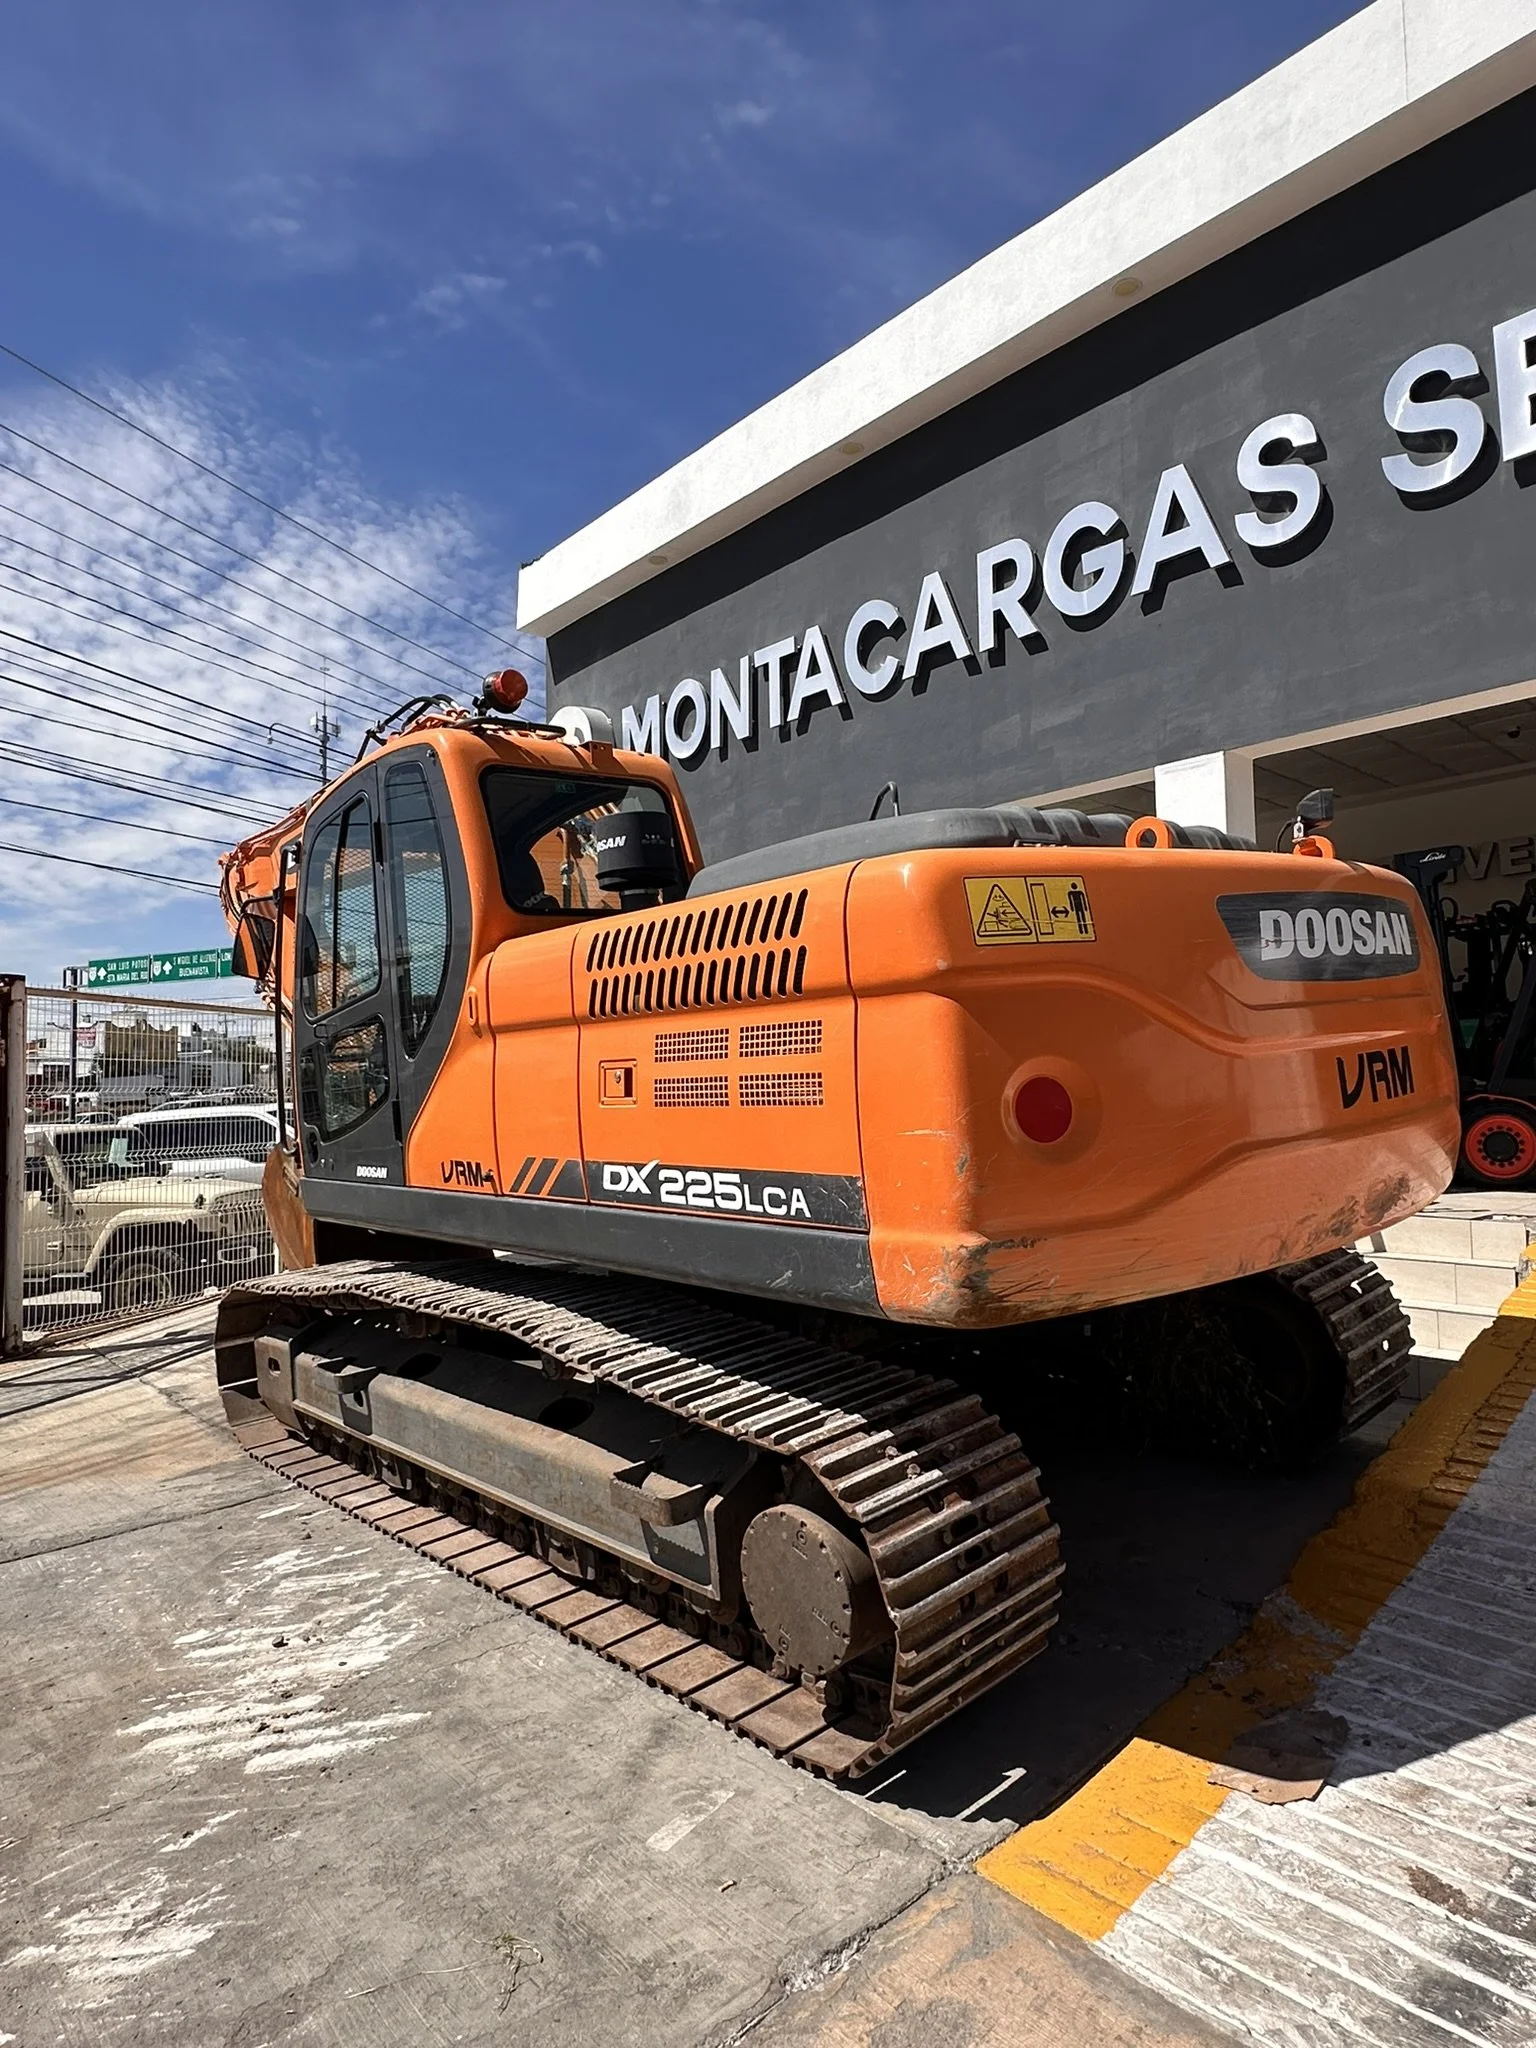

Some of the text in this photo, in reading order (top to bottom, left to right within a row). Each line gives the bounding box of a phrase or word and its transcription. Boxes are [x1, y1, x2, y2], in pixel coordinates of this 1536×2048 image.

[621, 413, 1322, 760] MONTACARGAS
[1419, 852, 1447, 863] Linde
[1259, 907, 1413, 961] DOOSAN
[119, 961, 130, 970] LUIS
[179, 966, 210, 977] BUENAVISTA
[1335, 1045, 1415, 1110] VRM
[356, 1165, 388, 1179] DOOSAN
